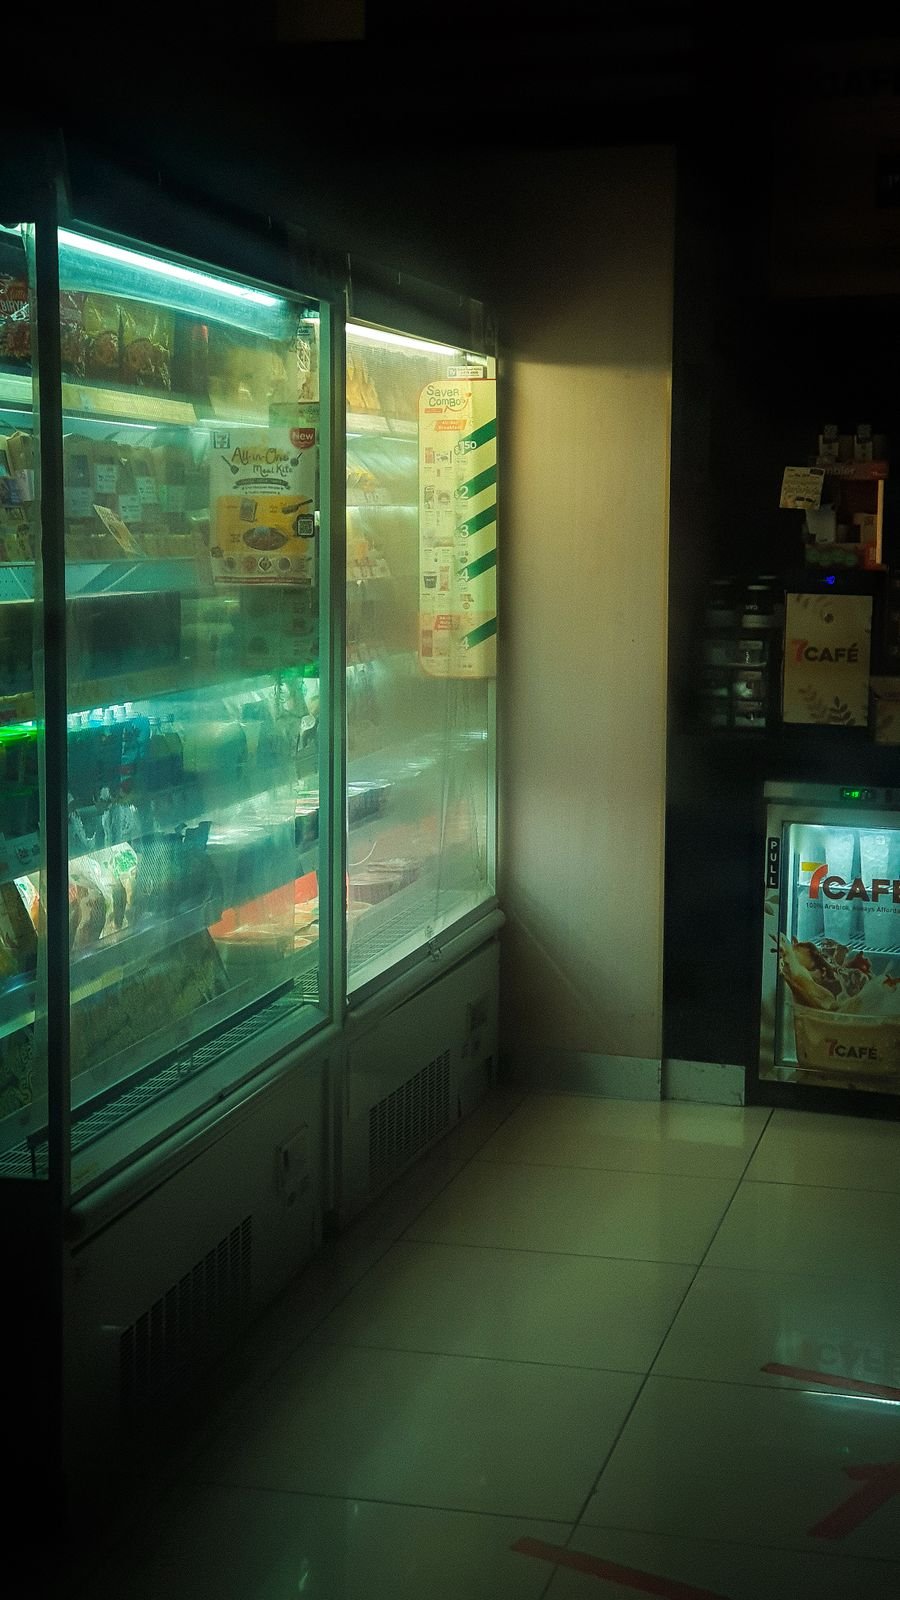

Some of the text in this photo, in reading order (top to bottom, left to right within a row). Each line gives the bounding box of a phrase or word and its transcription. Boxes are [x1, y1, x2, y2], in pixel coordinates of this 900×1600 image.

[292, 430, 314, 441] New
[253, 465, 274, 477] Meal
[770, 841, 778, 886] PULL
